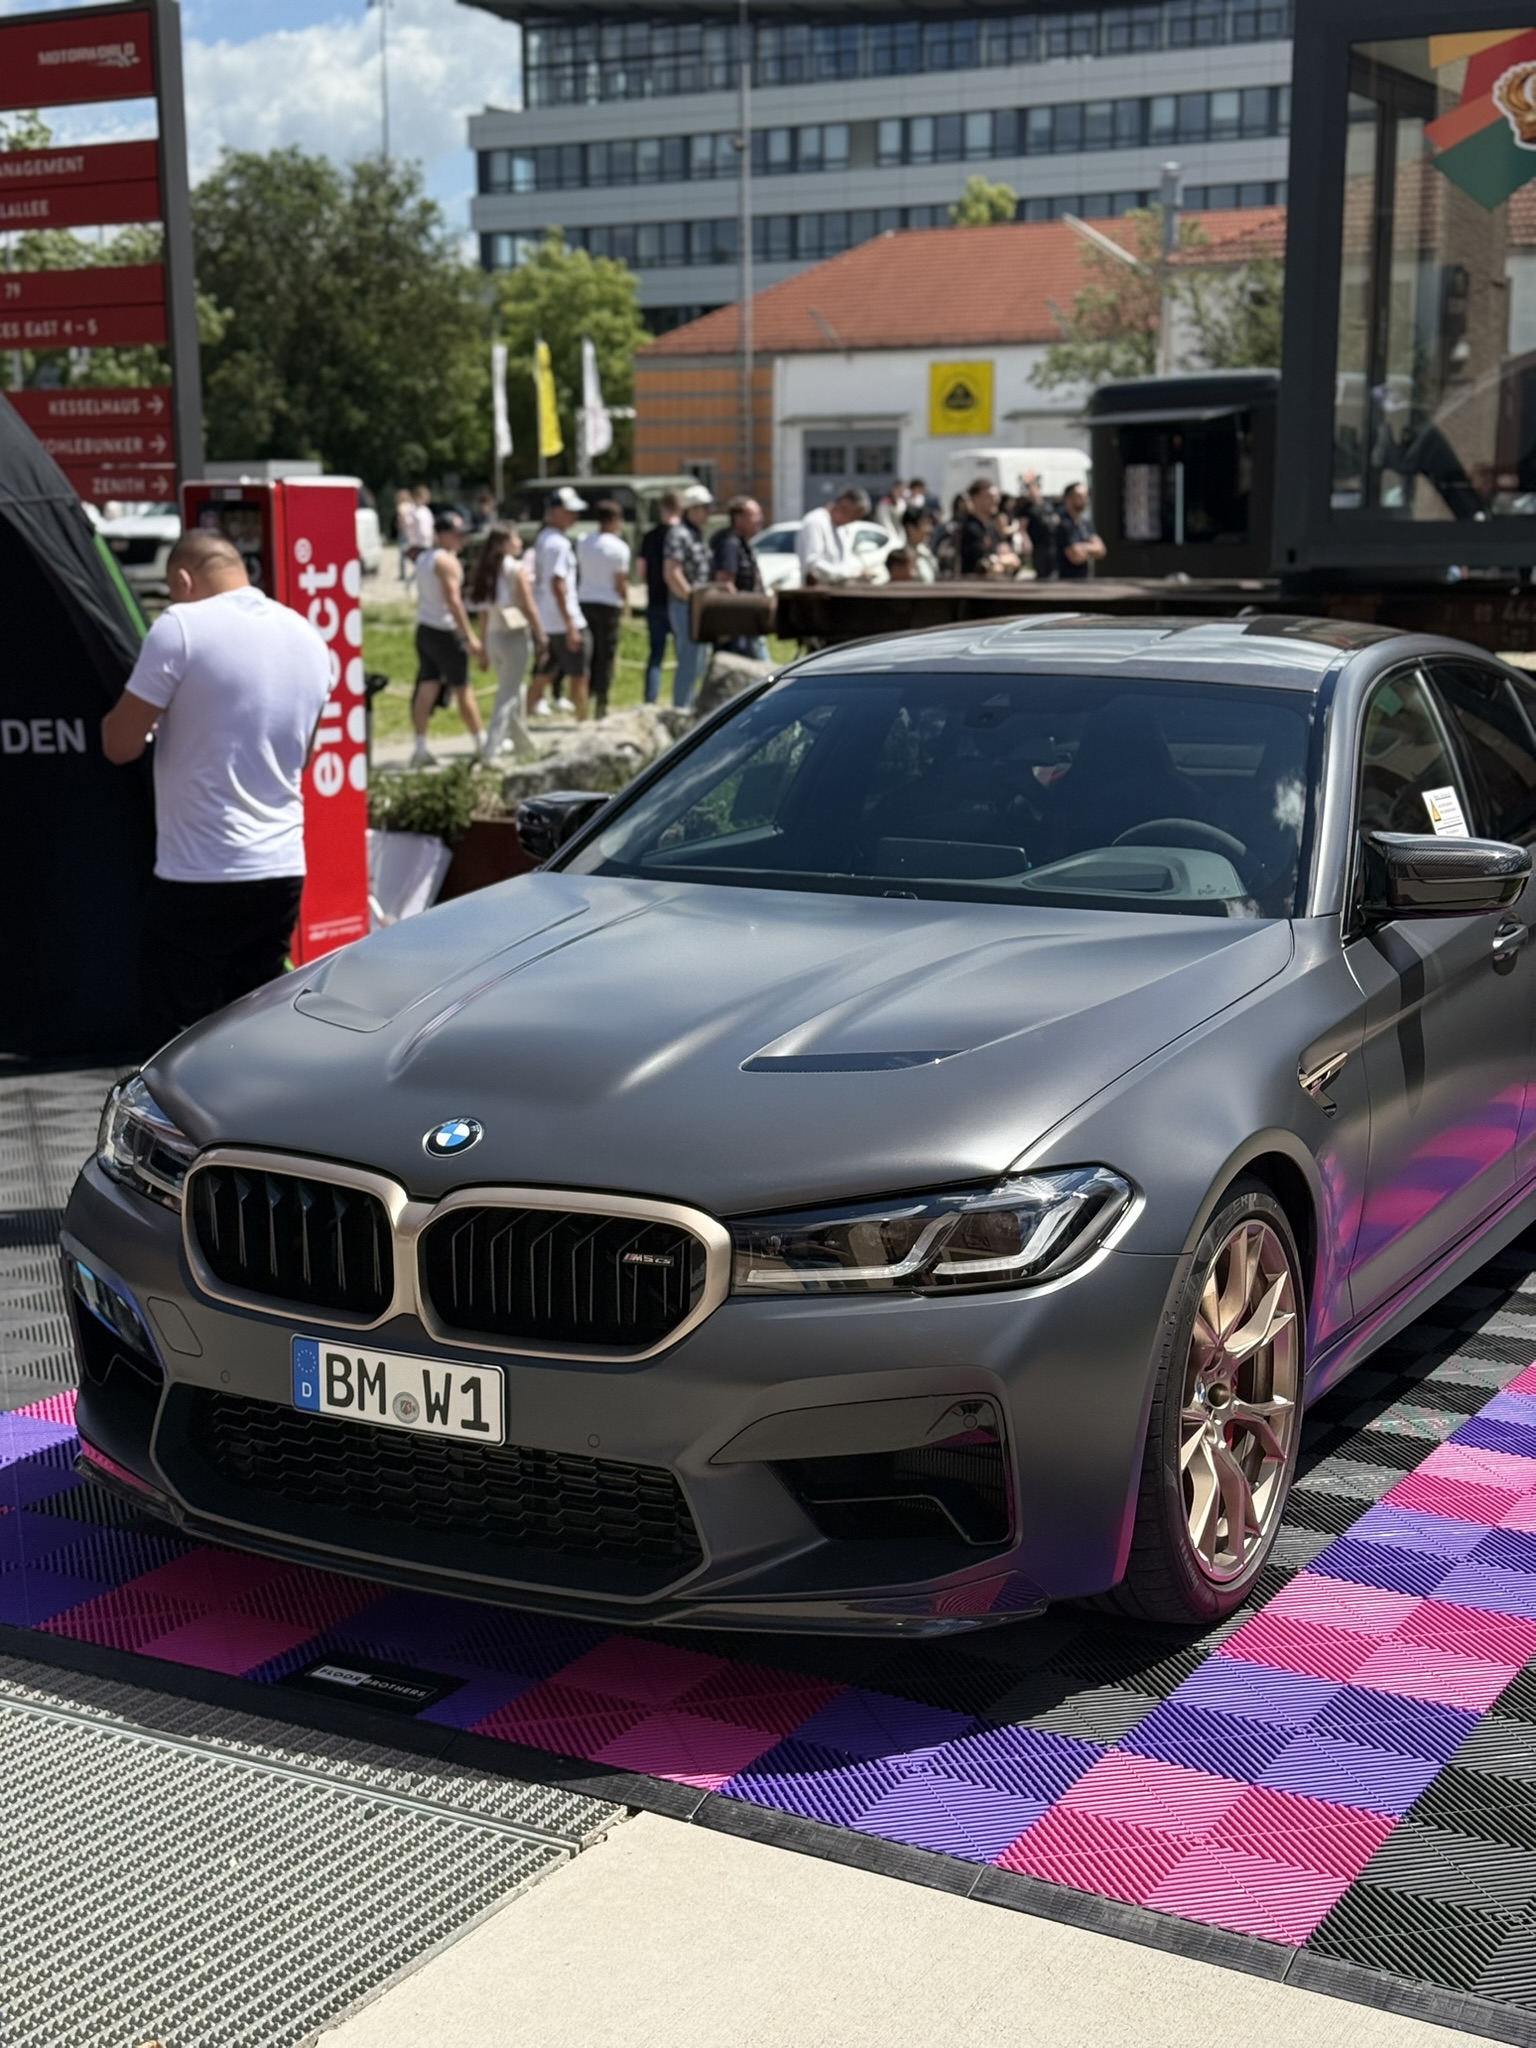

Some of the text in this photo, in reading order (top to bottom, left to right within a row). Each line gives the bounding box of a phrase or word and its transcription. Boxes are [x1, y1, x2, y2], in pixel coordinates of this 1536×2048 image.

[24, 320, 58, 338] EAST
[49, 397, 141, 416] KESSELHAUS
[92, 477, 146, 495] ZENITH
[0, 718, 87, 754] DEN
[302, 1381, 313, 1399] D
[325, 1352, 387, 1416] BM
[319, 1668, 428, 1698] FLOOR BROTHERS
